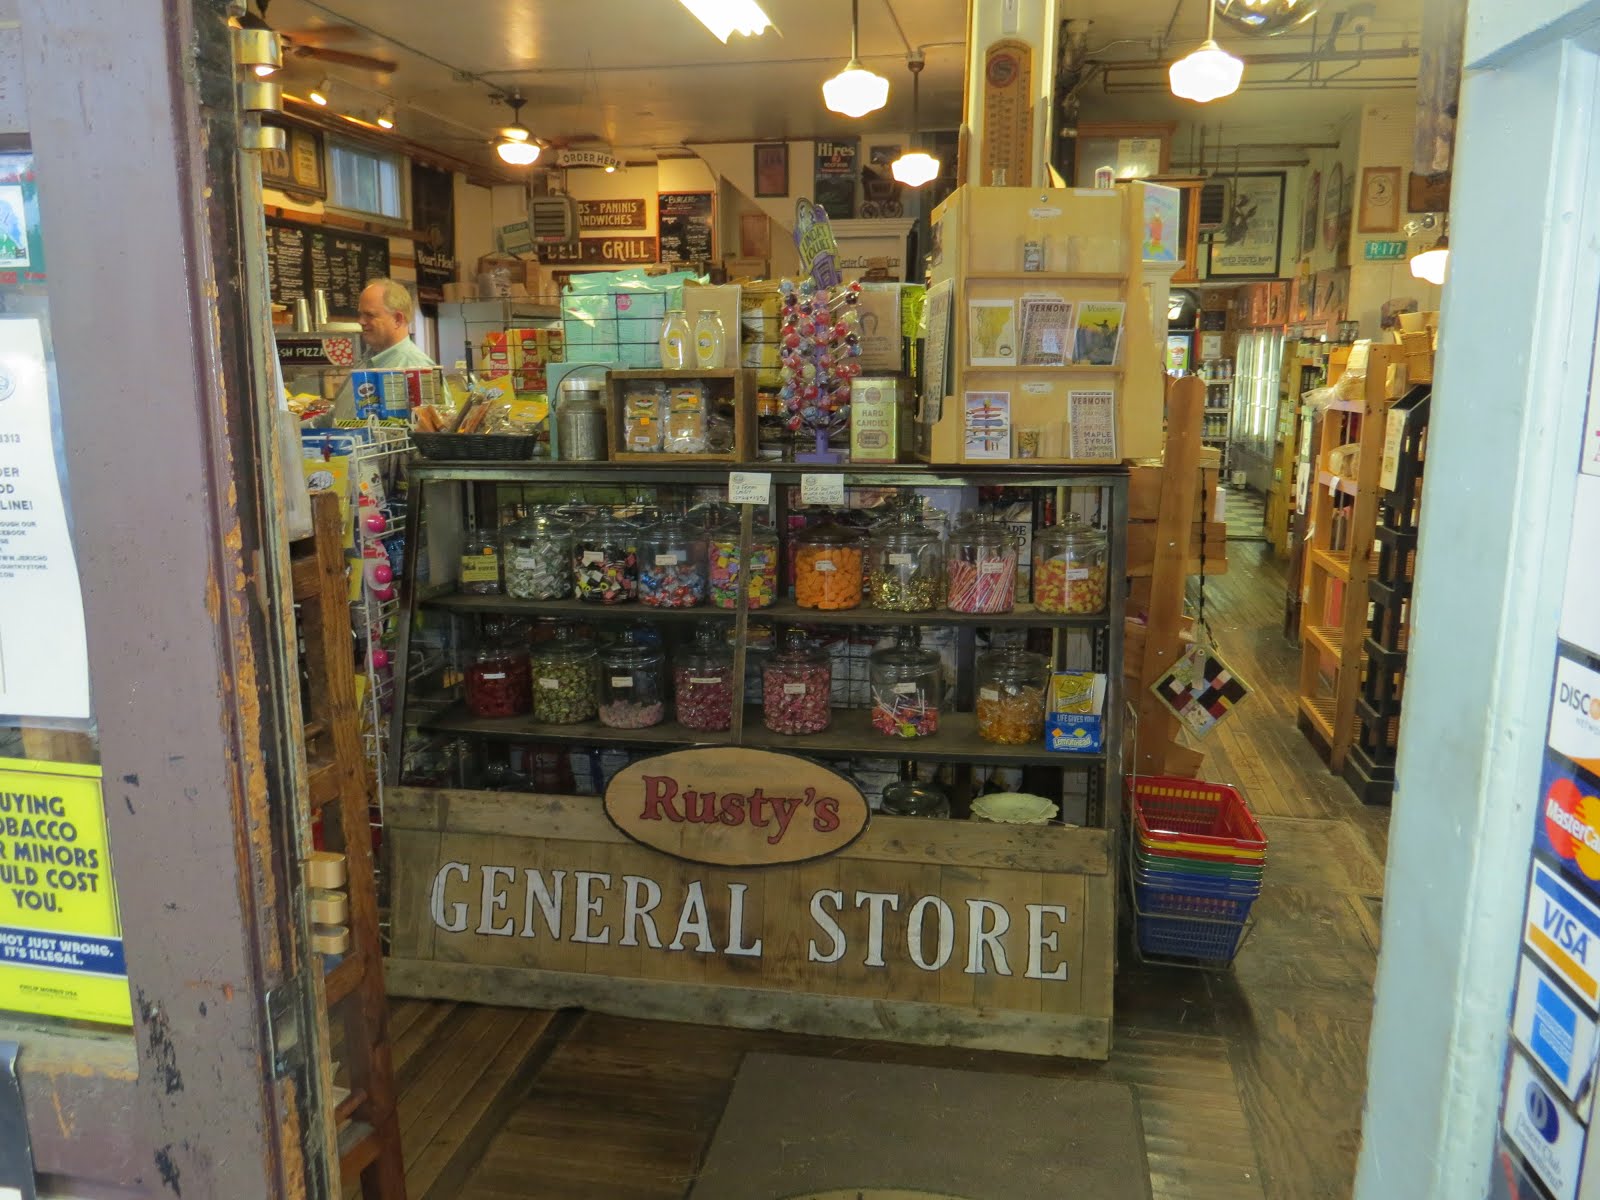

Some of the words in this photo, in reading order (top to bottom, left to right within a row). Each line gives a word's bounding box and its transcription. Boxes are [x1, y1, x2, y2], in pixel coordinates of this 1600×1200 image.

[563, 150, 595, 164] ORDER
[597, 154, 622, 168] HERE
[817, 143, 856, 157] Hires
[600, 202, 637, 214] PANINIS
[602, 241, 649, 261] GRILL
[1030, 303, 1071, 312] VERMONT
[295, 347, 325, 357] PIZZA
[1072, 397, 1111, 405] VERMONT
[862, 409, 884, 417] HARD
[856, 419, 889, 427] CANDIES
[640, 775, 840, 845] Rusty's
[14, 842, 99, 869] MINORS
[46, 868, 98, 892] COST
[12, 888, 63, 912] YOU.
[430, 861, 763, 957] GENERAL
[808, 888, 1069, 981] STORE
[1544, 899, 1588, 965] VISA
[4, 946, 27, 959] IT'S
[29, 949, 84, 965] ILLEGAL.
[27, 936, 57, 951] JUST
[60, 941, 114, 957] WRONG.
